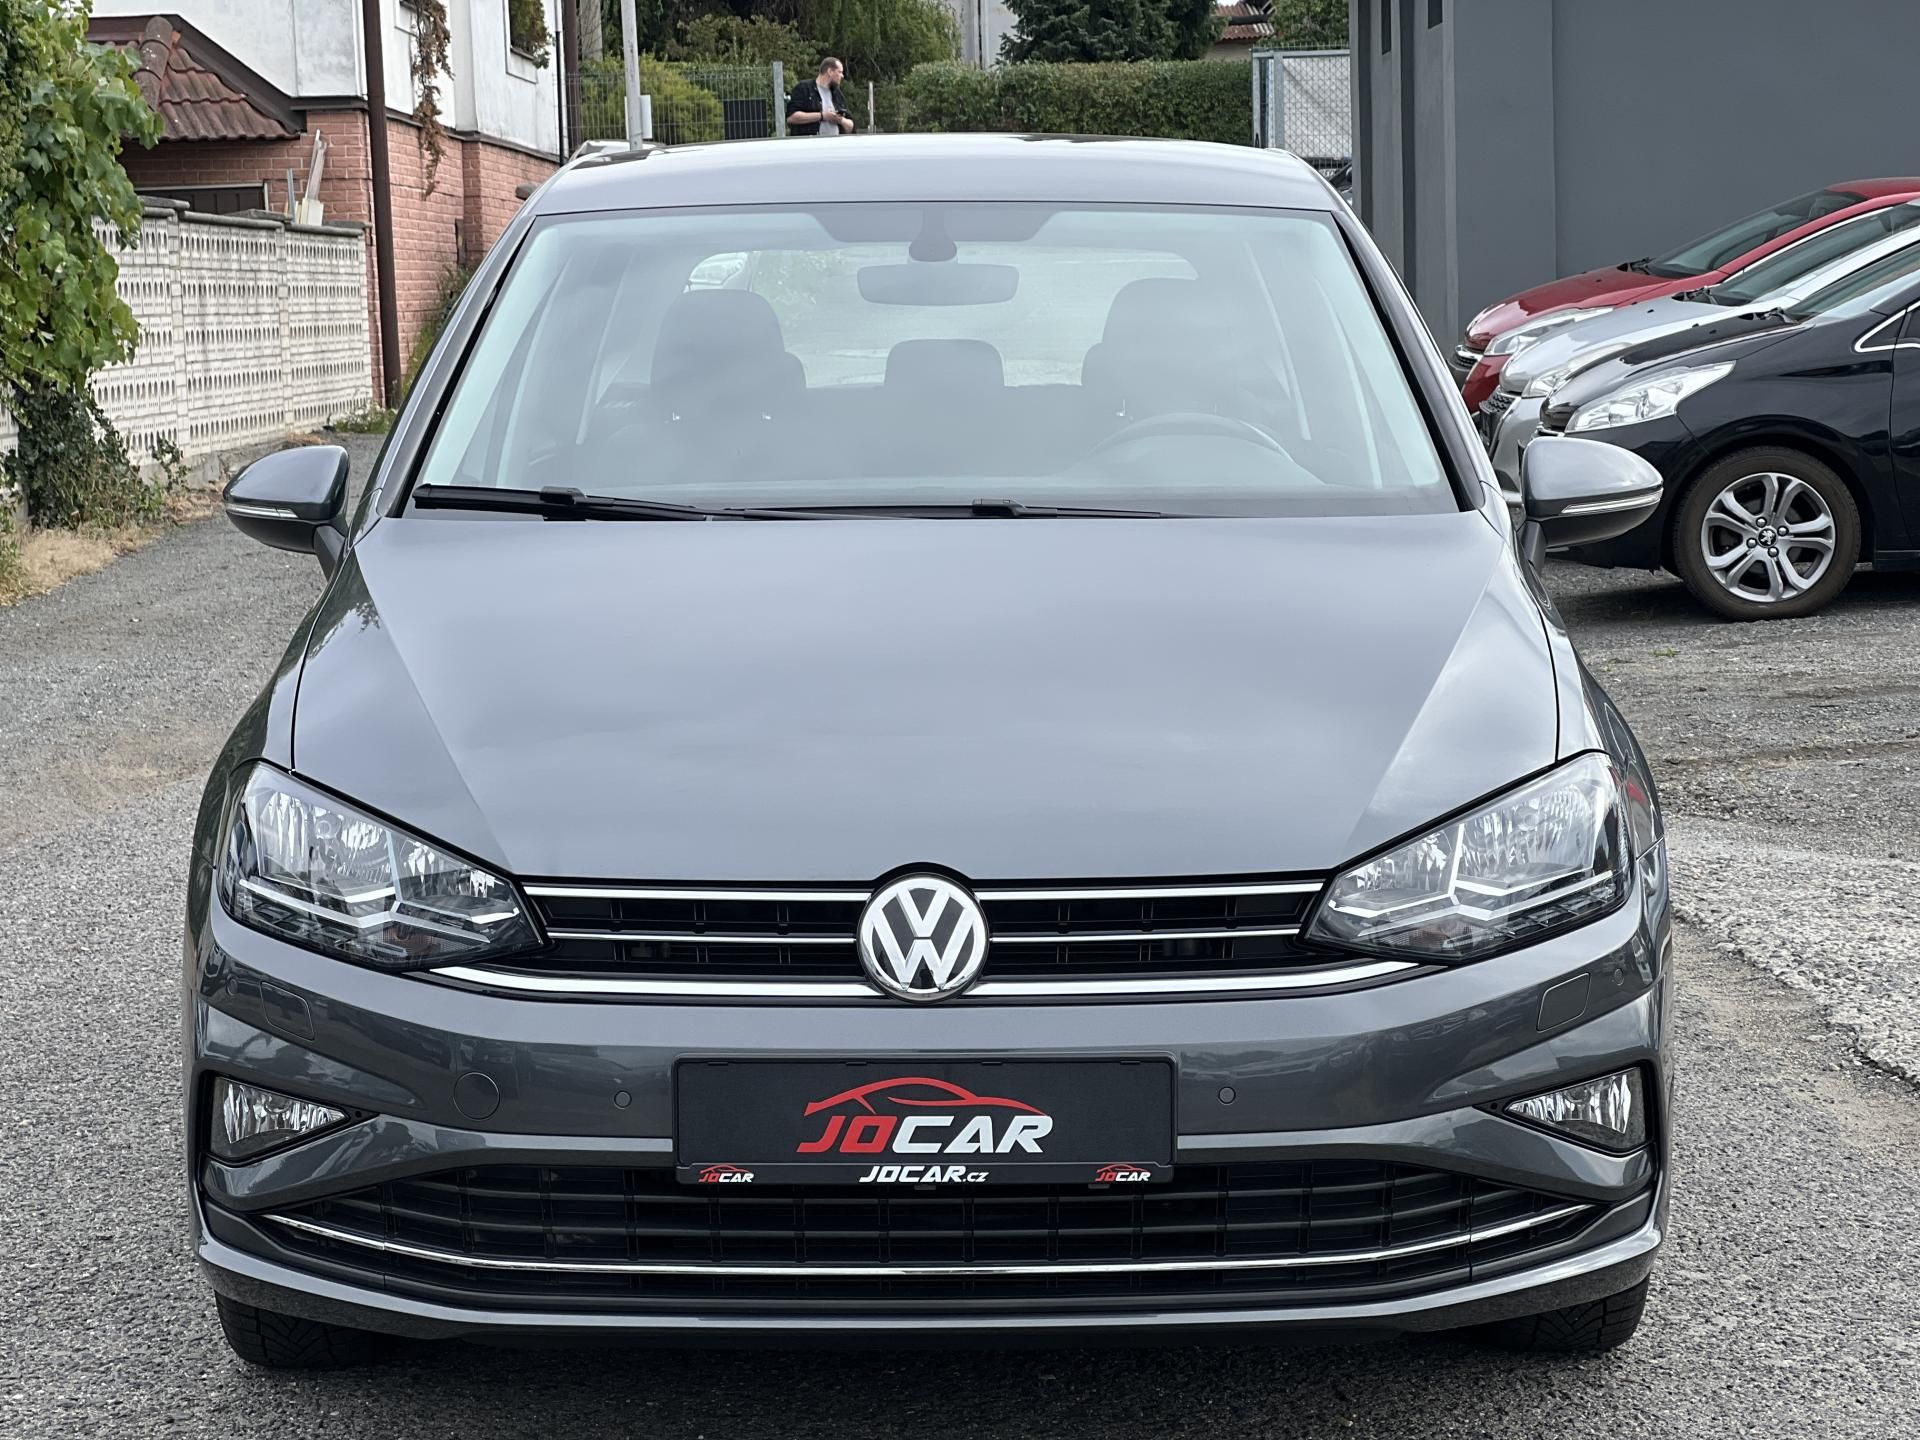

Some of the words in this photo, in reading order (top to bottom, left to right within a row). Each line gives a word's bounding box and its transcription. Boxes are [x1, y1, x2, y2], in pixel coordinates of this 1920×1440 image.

[862, 877, 985, 996] VW
[796, 1115, 1053, 1154] JOCAR
[698, 1172, 755, 1183] JOCAR
[1095, 1171, 1152, 1182] JOCAR
